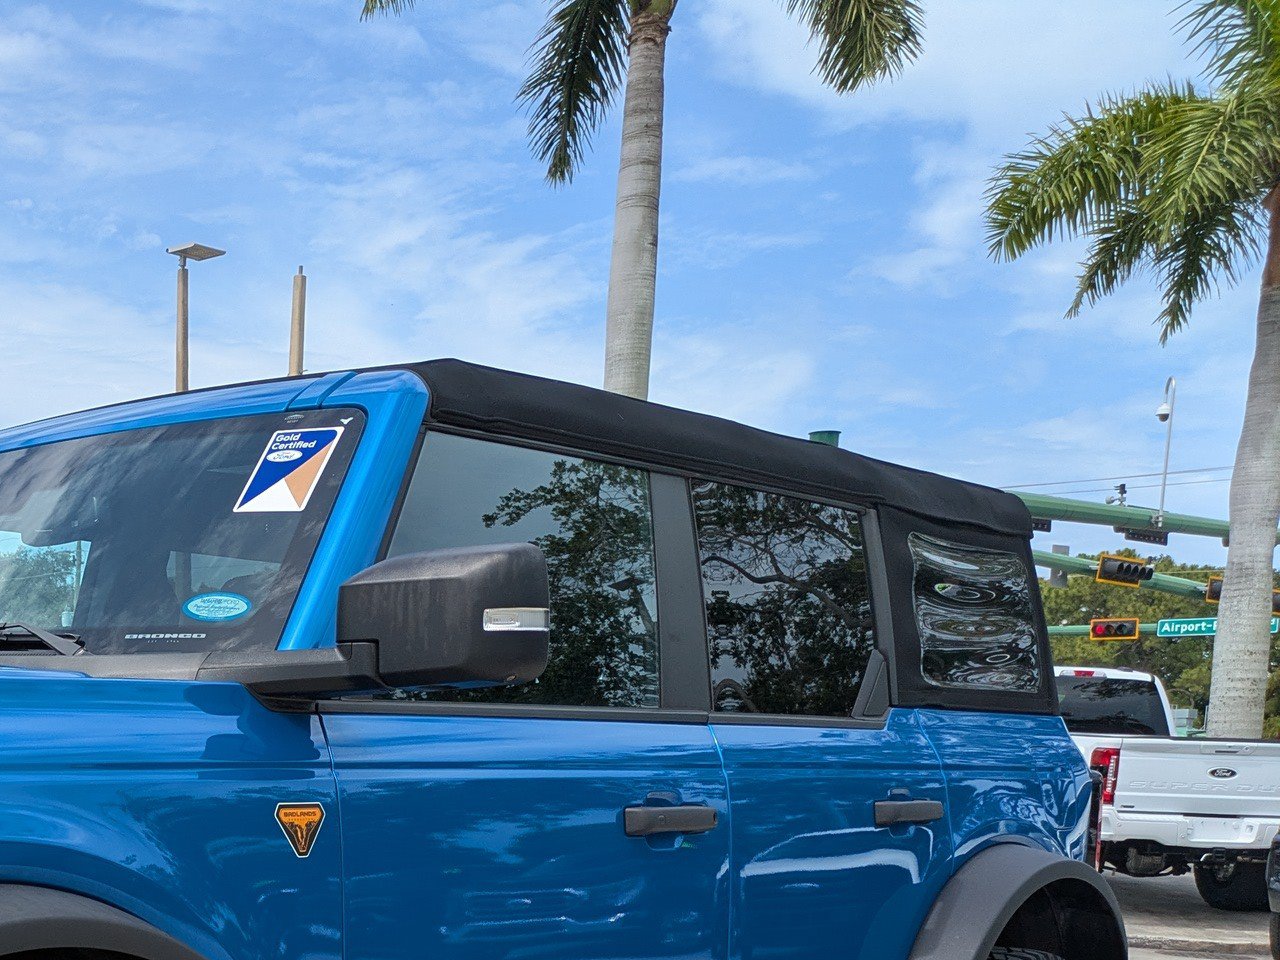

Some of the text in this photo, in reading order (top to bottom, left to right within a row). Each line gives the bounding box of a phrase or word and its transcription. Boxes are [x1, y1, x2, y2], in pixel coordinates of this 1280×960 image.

[276, 433, 301, 442] Gold
[271, 440, 317, 450] Certified
[1129, 780, 1280, 793] SUPER DU
[283, 810, 317, 818] BADLANDS
